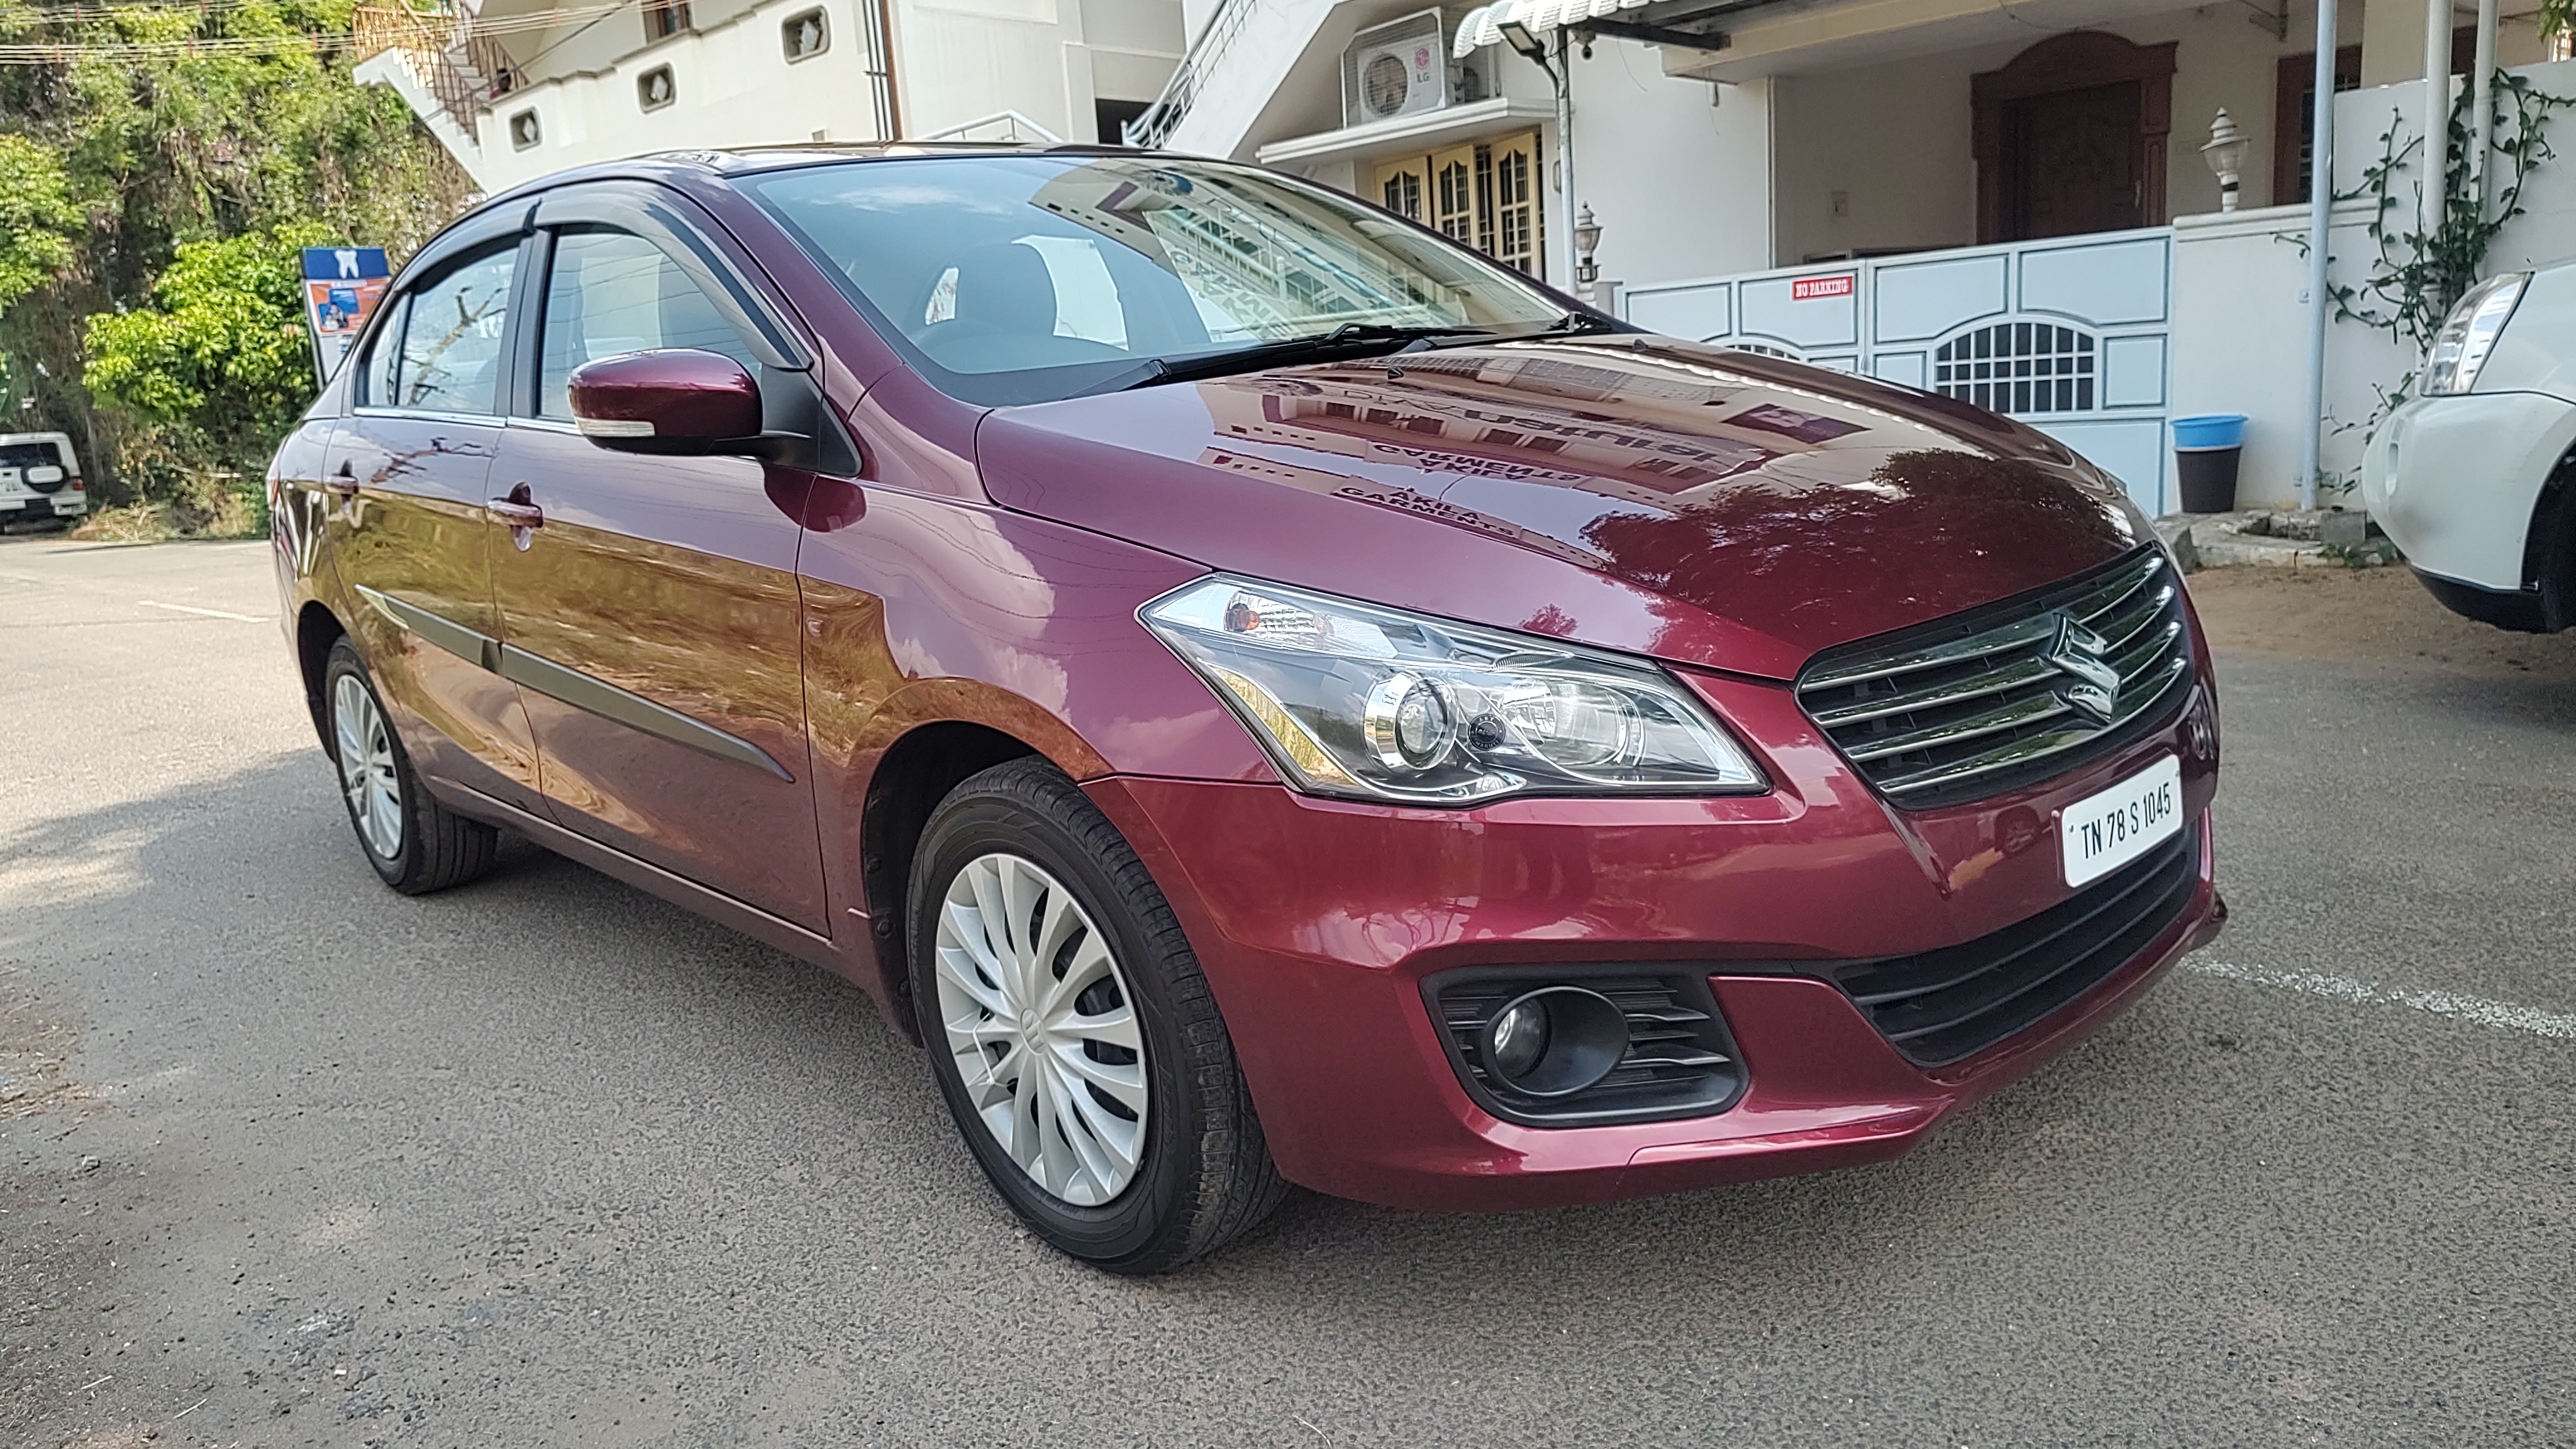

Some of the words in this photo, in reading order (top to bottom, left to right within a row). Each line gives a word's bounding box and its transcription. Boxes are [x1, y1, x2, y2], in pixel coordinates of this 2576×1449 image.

[1416, 72, 1430, 83] LG
[1796, 283, 1808, 297] NO
[1809, 279, 1848, 296] PARKING
[1340, 487, 1514, 536] GARMENTS
[1389, 491, 1481, 521] AKILA
[2081, 818, 2102, 859] TN
[2107, 809, 2126, 848] 78
[2130, 801, 2139, 835] S
[2143, 781, 2171, 828] 1045
